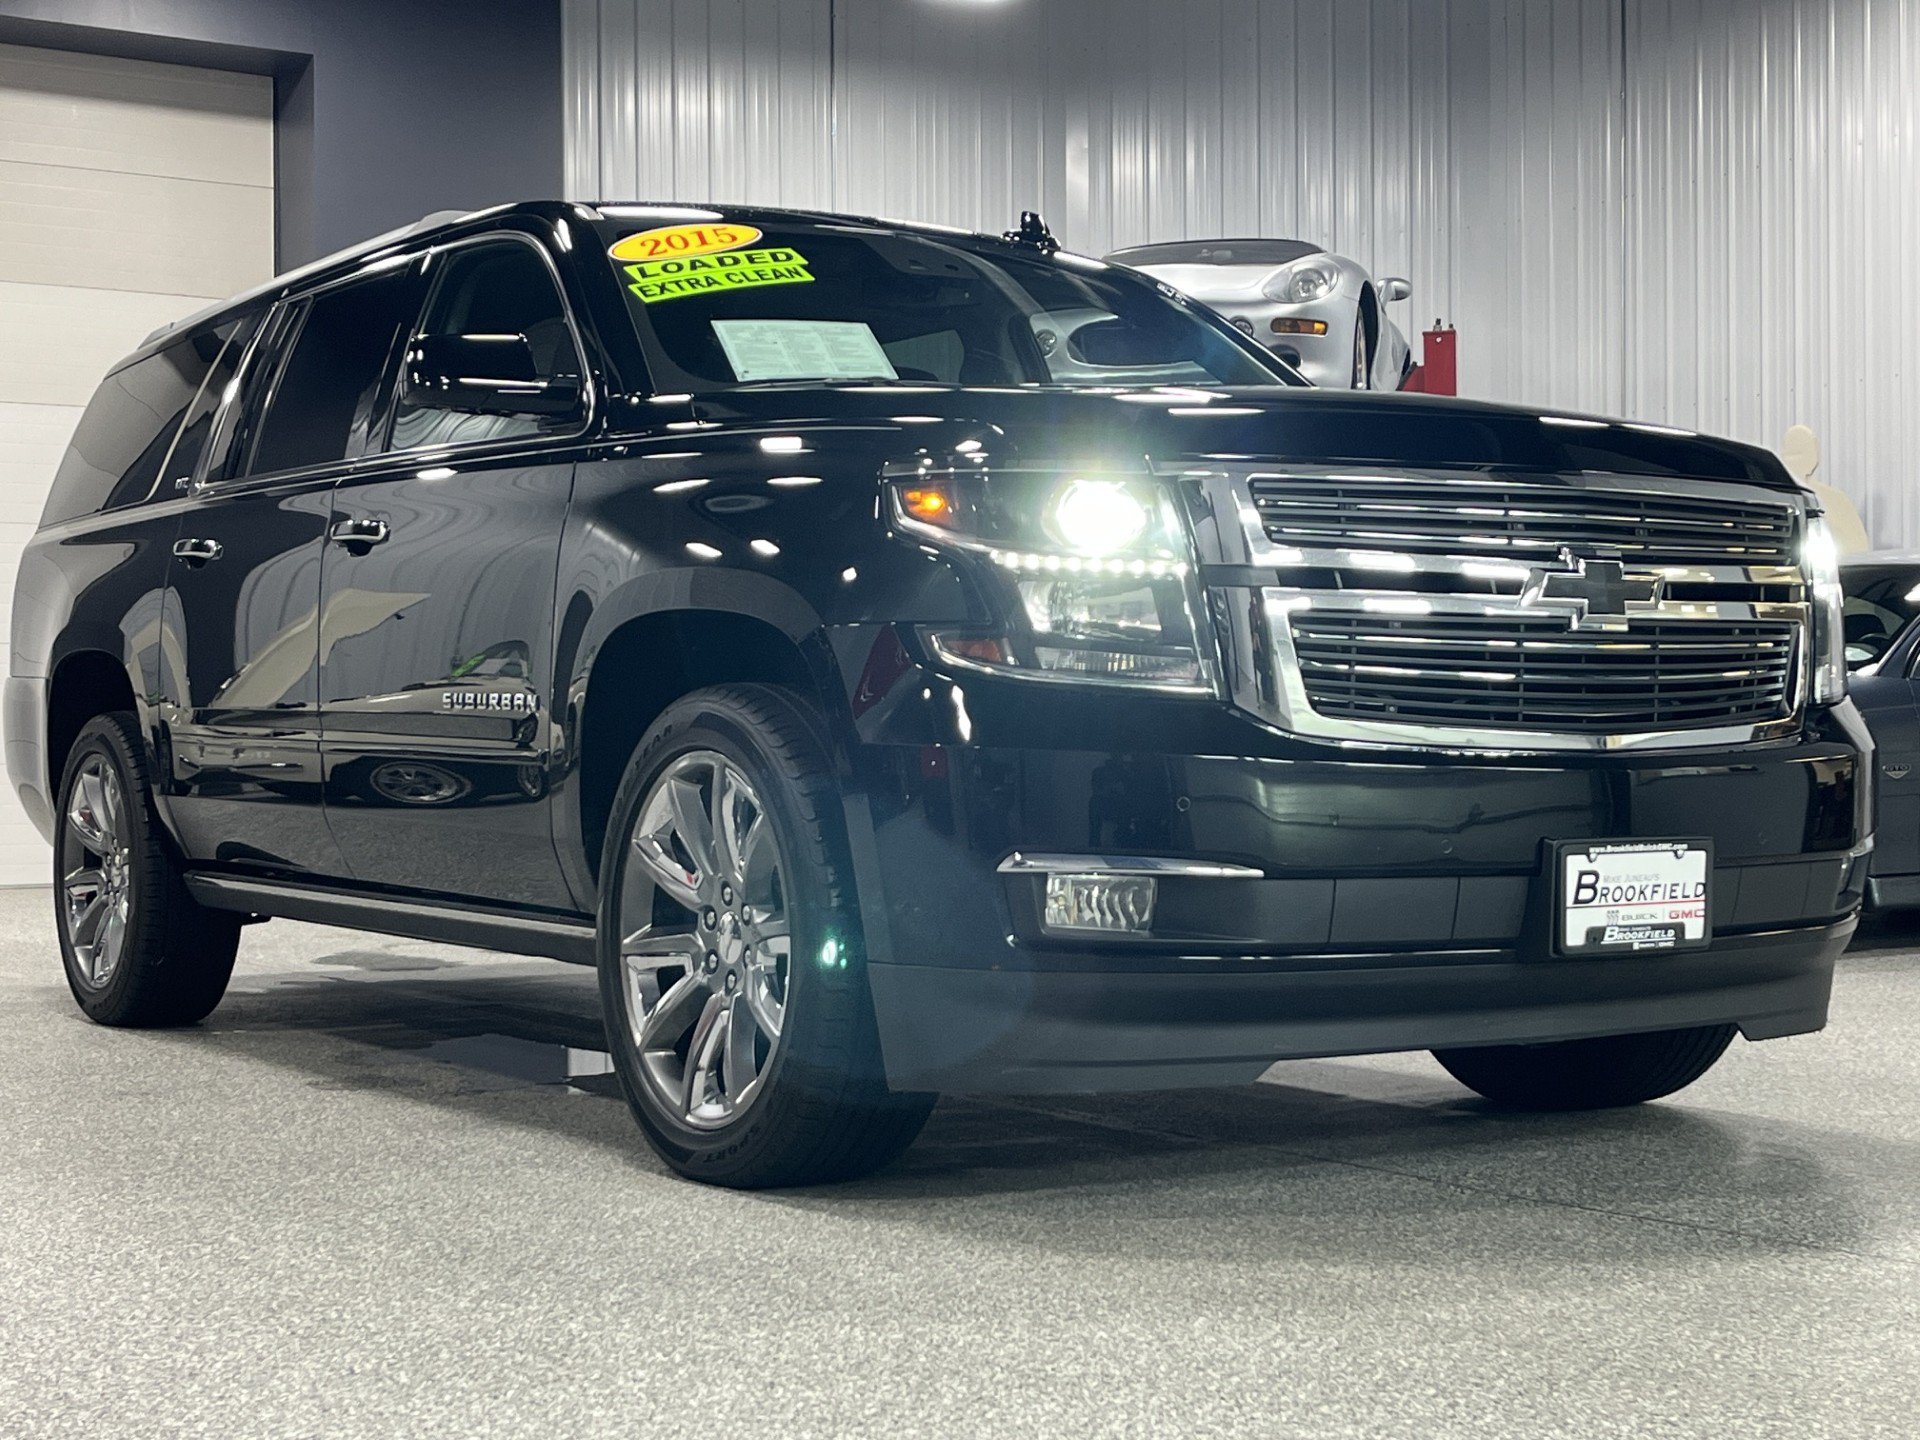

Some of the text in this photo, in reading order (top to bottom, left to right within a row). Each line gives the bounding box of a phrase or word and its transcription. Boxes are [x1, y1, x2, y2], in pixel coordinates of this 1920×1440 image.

[640, 227, 738, 257] 2015
[636, 252, 795, 279] LOADED
[640, 266, 804, 299] EXTRA CLEAN
[442, 692, 538, 714] SUBURBAN
[1572, 869, 1706, 905] BROOKFIELD
[1622, 909, 1705, 921] BUICK GMC
[1603, 926, 1676, 941] BROOKFIELD
